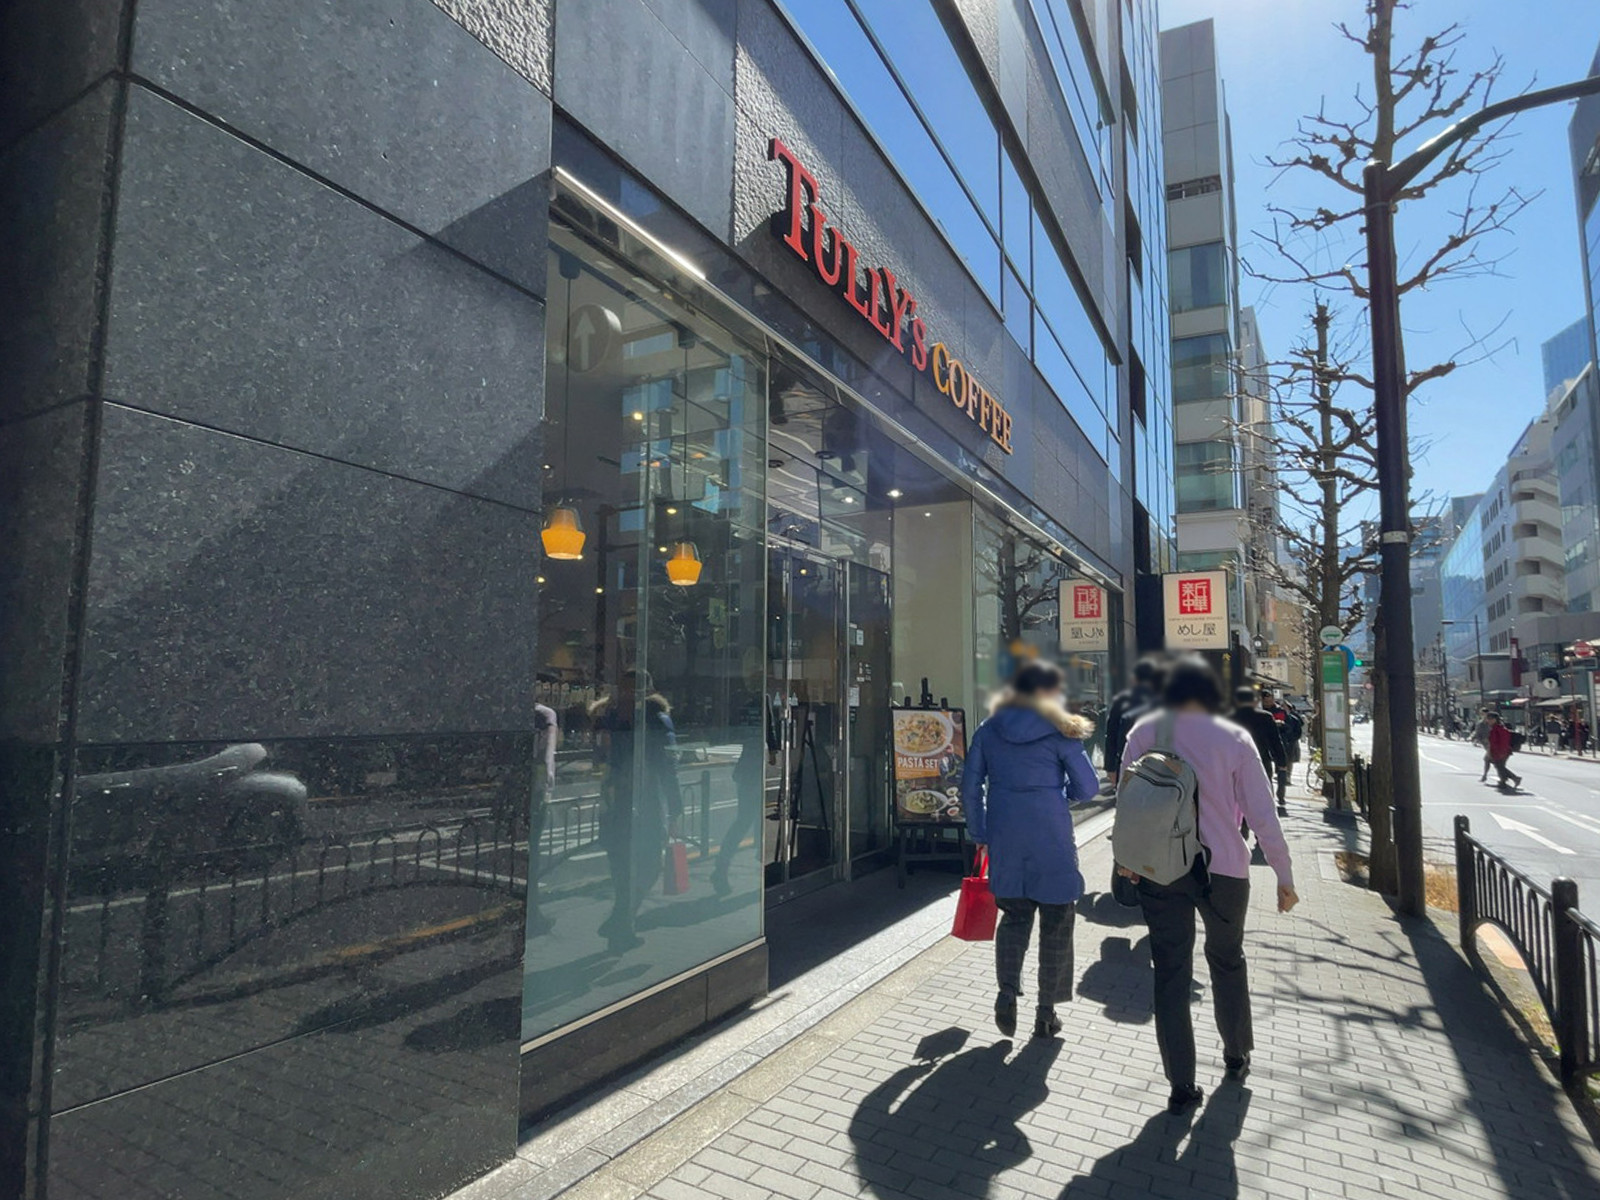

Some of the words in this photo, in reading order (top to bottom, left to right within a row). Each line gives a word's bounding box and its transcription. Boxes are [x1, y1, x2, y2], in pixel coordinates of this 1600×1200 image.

[769, 138, 927, 371] TULLY'S
[932, 342, 1013, 455] COFFEE
[1177, 623, 1217, 636] めし屋
[897, 757, 924, 768] PASTA
[925, 759, 938, 768] SET
